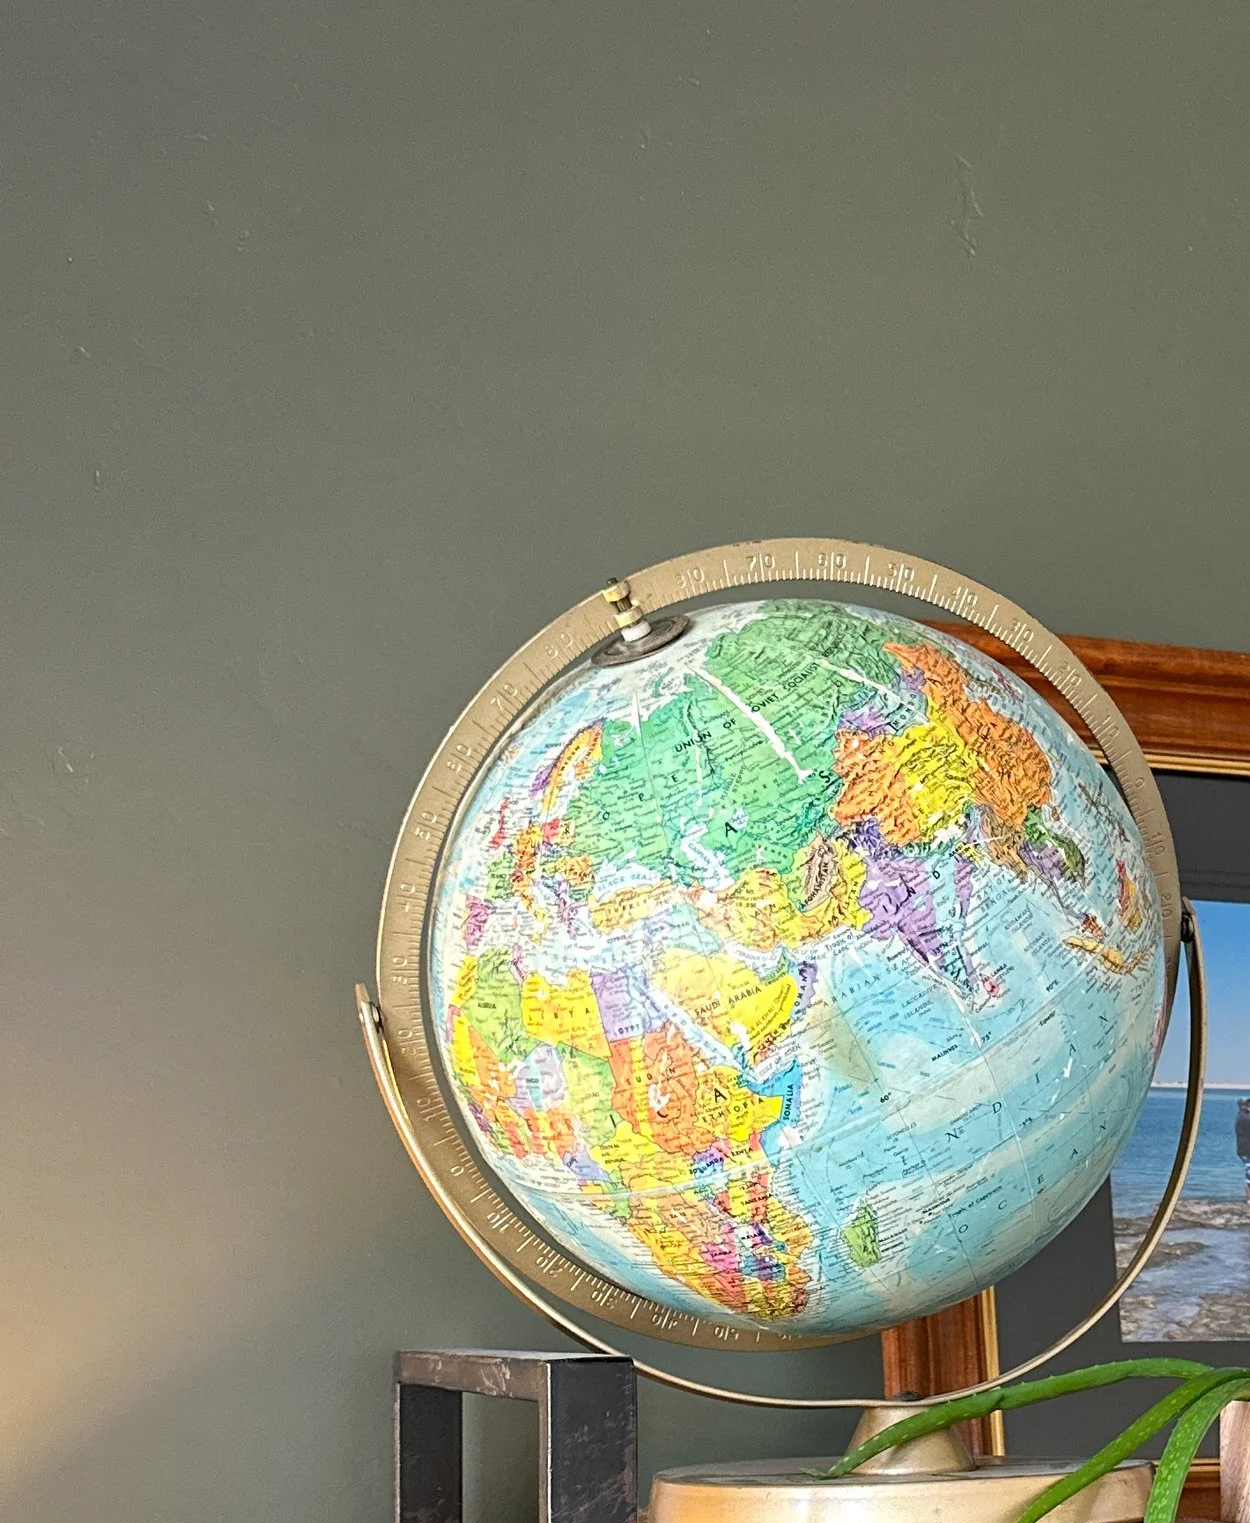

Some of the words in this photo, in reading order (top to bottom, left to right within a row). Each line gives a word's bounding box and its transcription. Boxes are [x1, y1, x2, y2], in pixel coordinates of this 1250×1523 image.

[745, 552, 777, 572] 70
[817, 551, 847, 568] 60
[887, 561, 915, 582] 50
[951, 586, 978, 606] 40
[1011, 617, 1034, 642] 30
[1059, 660, 1081, 688] 20
[489, 683, 519, 711] 70
[674, 731, 713, 753] UNION
[722, 718, 737, 730] OF
[751, 692, 780, 713] OVIET
[782, 661, 820, 692] SOCIALIST
[631, 873, 647, 881] SEA
[799, 862, 829, 909] AFGHANISTAN
[694, 1000, 721, 1016] SAUDI
[728, 986, 762, 1005] ARABIA
[931, 1044, 958, 1062] MALDIVES
[702, 1097, 765, 1123] ETHIOPIA
[782, 1084, 794, 1121] SOMALIA
[880, 1091, 892, 1104] 60°
